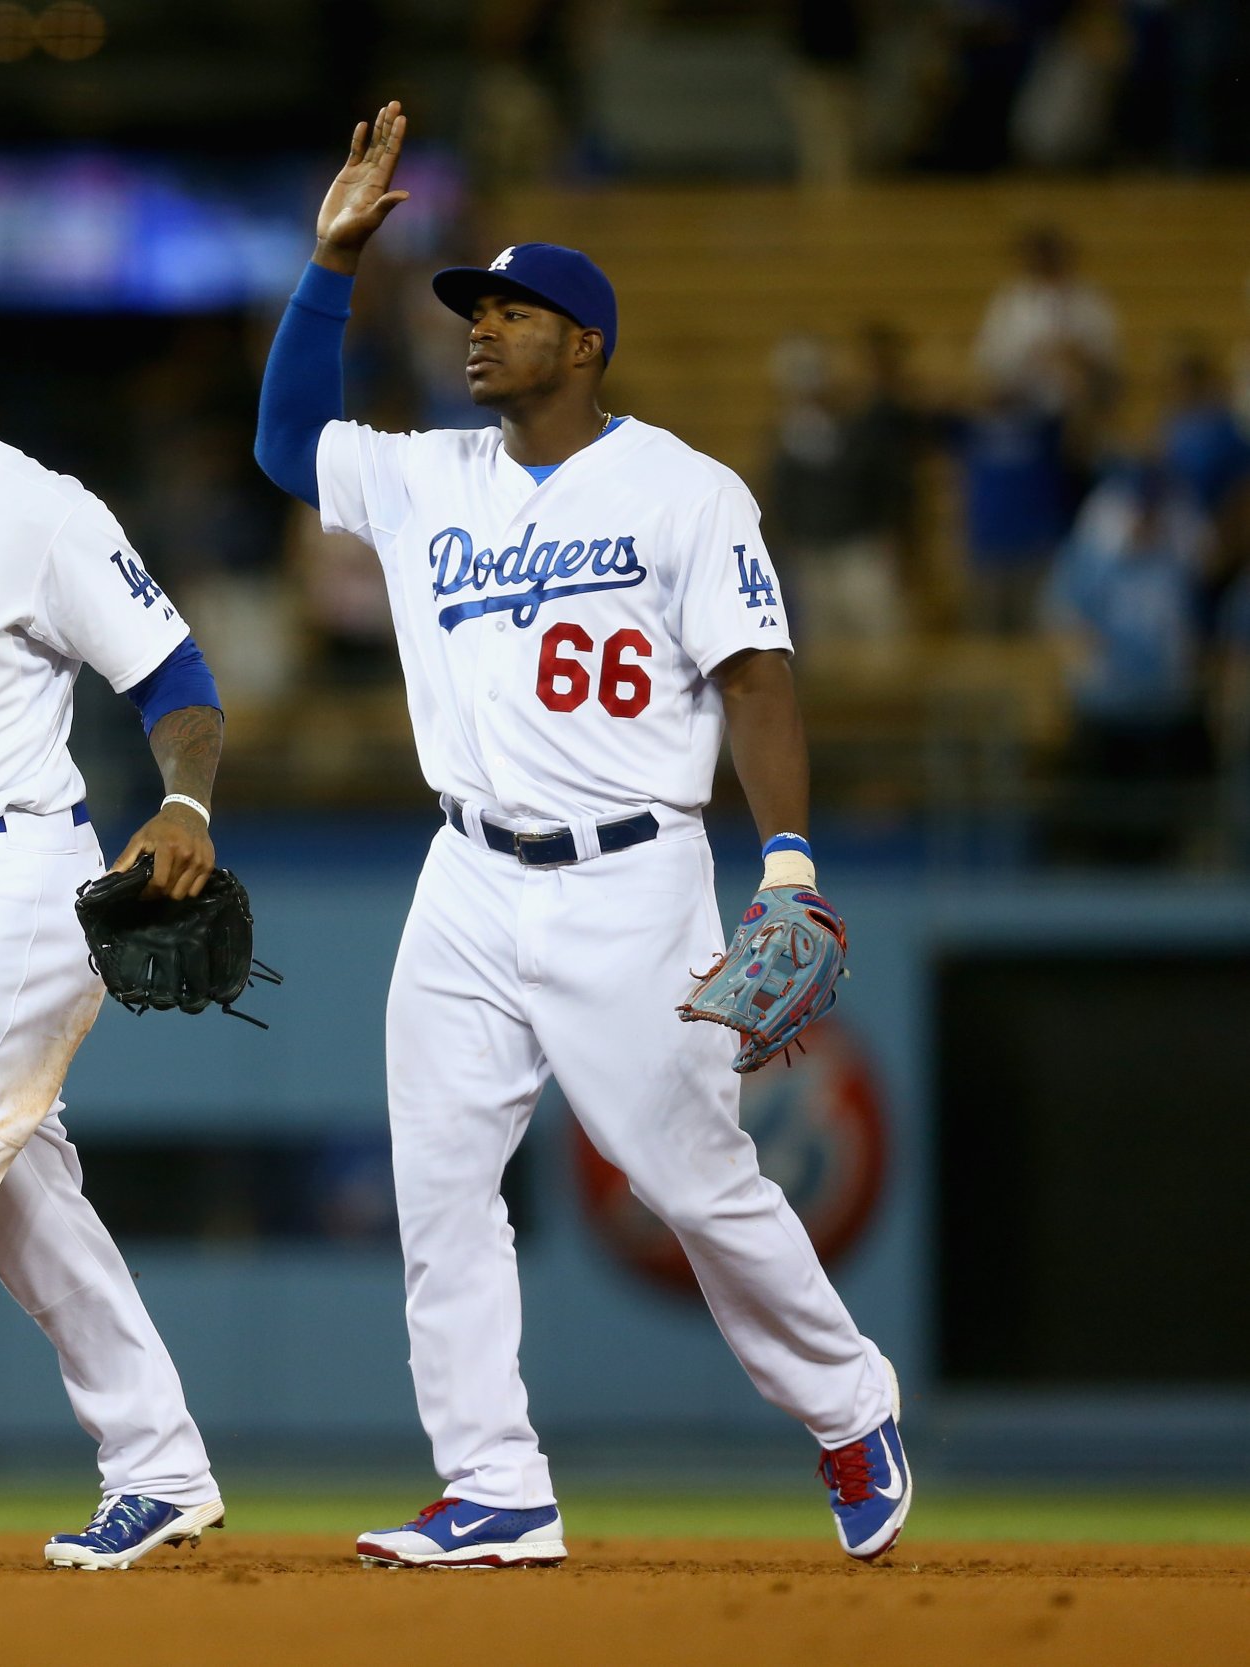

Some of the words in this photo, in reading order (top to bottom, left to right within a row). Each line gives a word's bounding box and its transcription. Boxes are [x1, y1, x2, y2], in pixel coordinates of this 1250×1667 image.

[110, 550, 162, 609] LA
[429, 522, 647, 635] Dodgers
[733, 544, 777, 609] LA
[535, 621, 653, 719] 66
